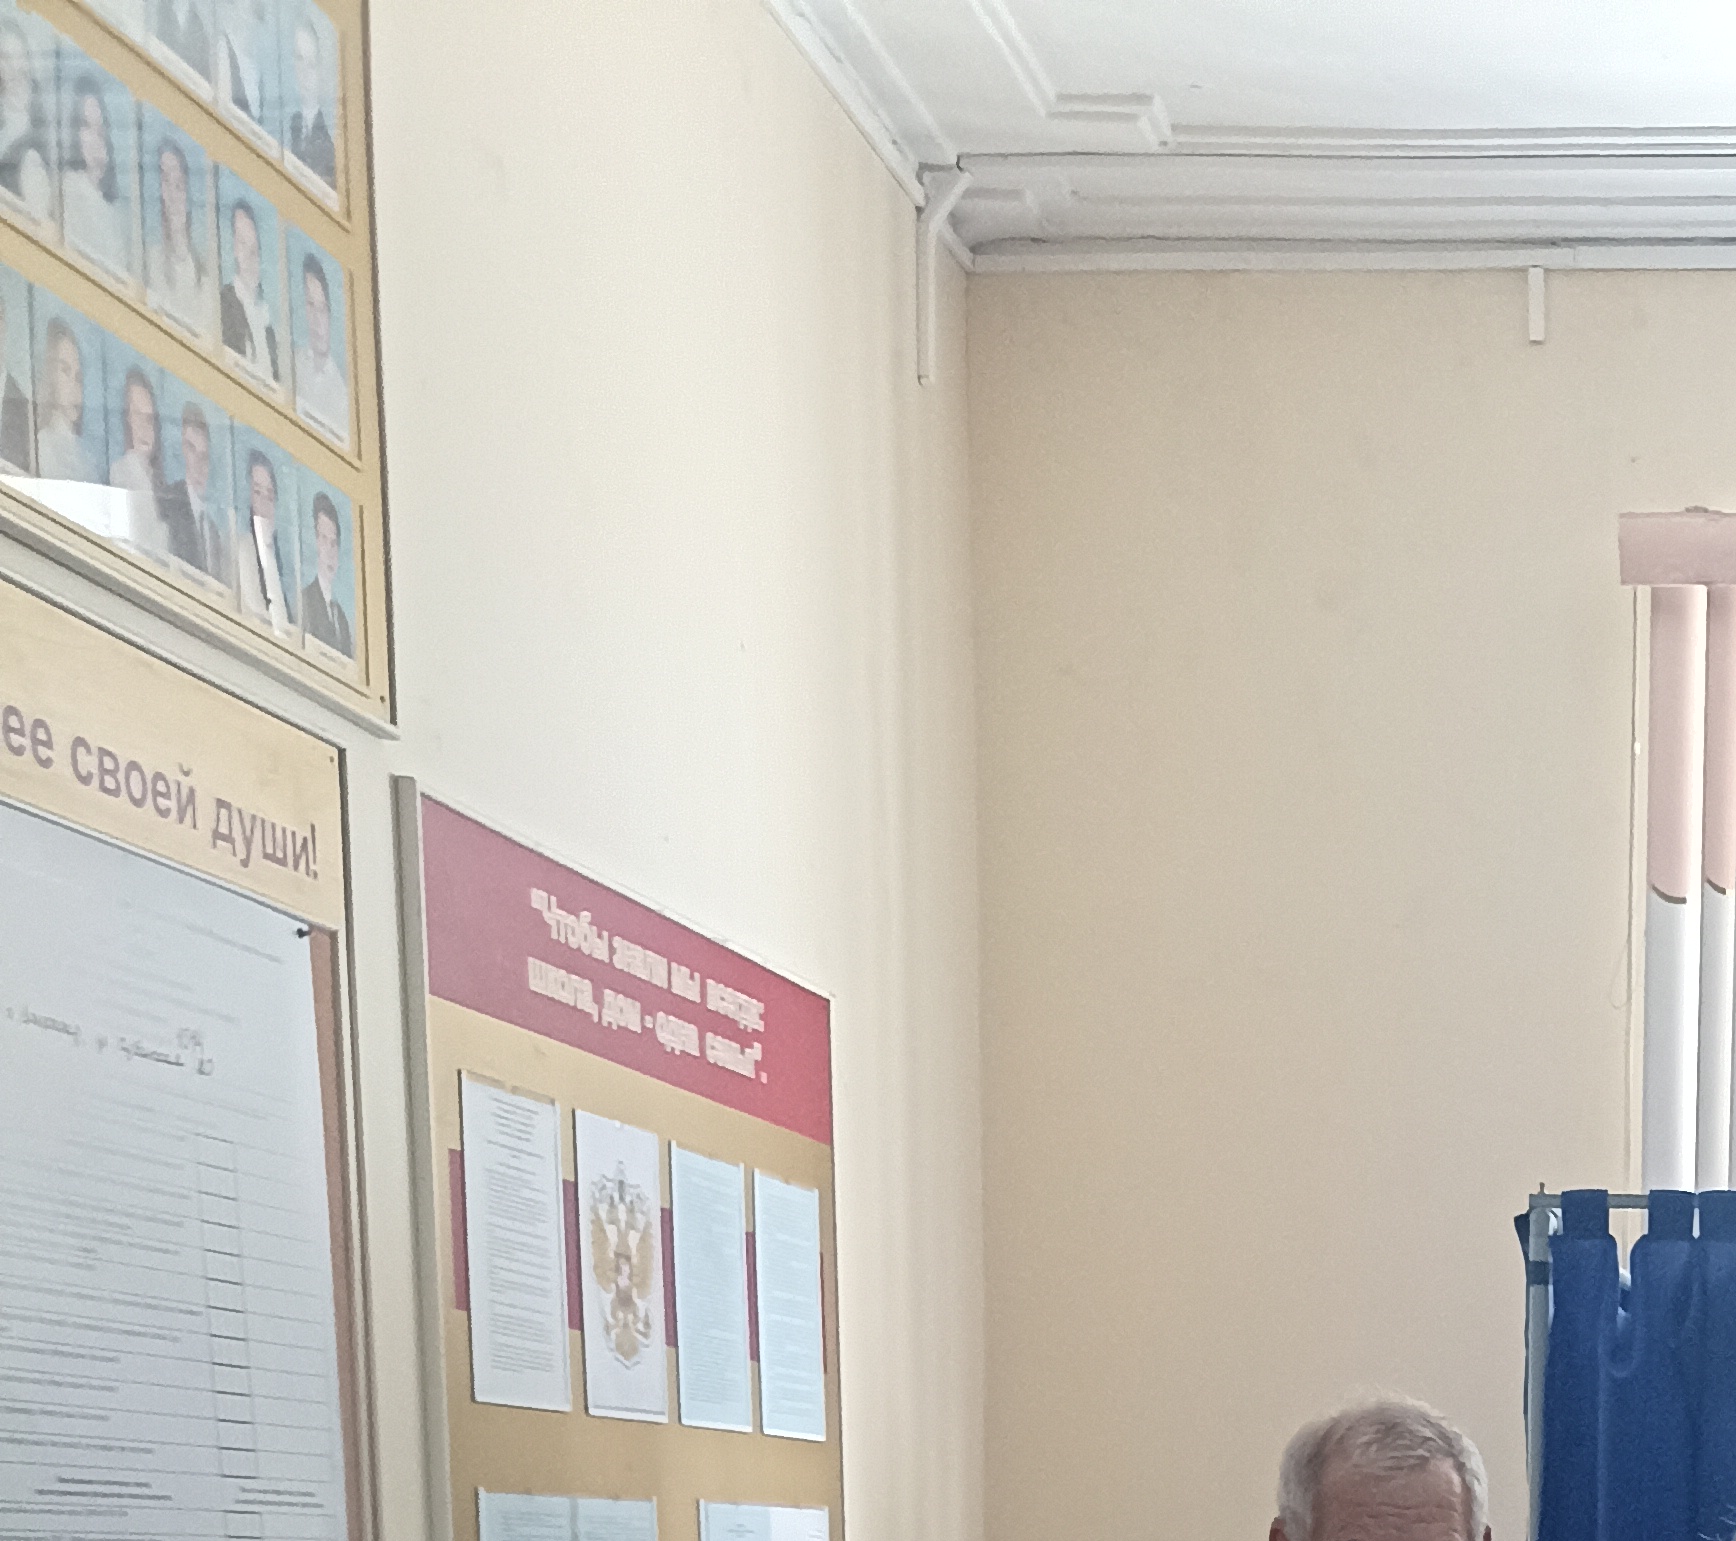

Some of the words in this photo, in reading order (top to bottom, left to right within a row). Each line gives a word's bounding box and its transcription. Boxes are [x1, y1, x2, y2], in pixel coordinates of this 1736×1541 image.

[70, 735, 199, 831] своей
[211, 797, 319, 880] души!
[527, 956, 599, 1024] школа,
[601, 988, 642, 1033] дом
[670, 961, 701, 1003] мы
